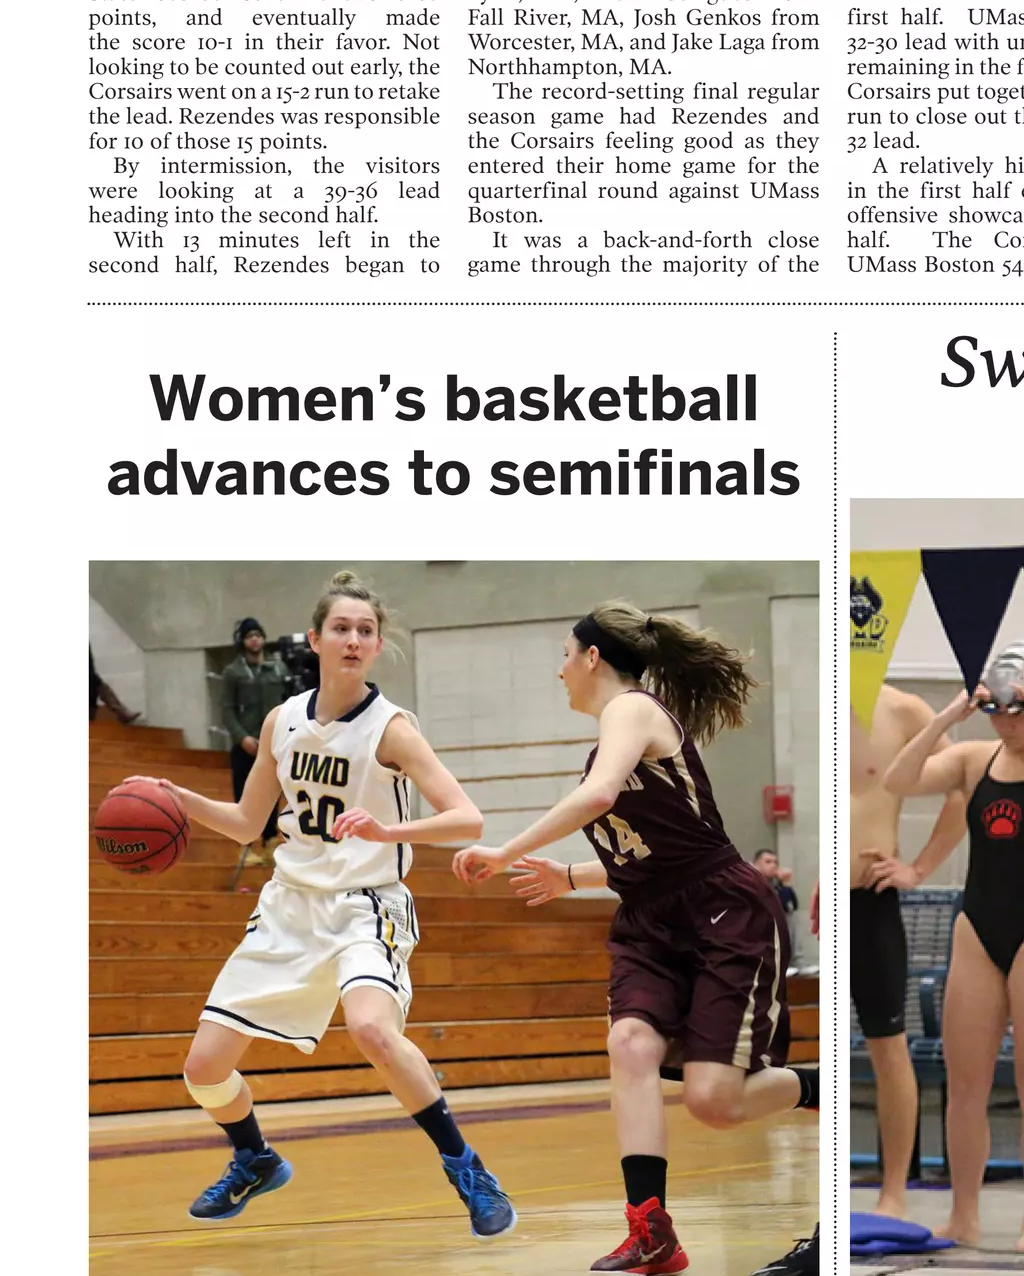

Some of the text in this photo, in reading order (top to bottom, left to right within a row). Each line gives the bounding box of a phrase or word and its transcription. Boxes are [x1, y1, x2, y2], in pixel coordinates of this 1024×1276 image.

[848, 8, 888, 25] first
[901, 8, 943, 25] half.
[447, 374, 756, 421] basketball
[108, 448, 800, 495] advances to semifinals
[290, 750, 350, 788] UMD
[296, 789, 346, 844] 20
[593, 813, 652, 866] 14
